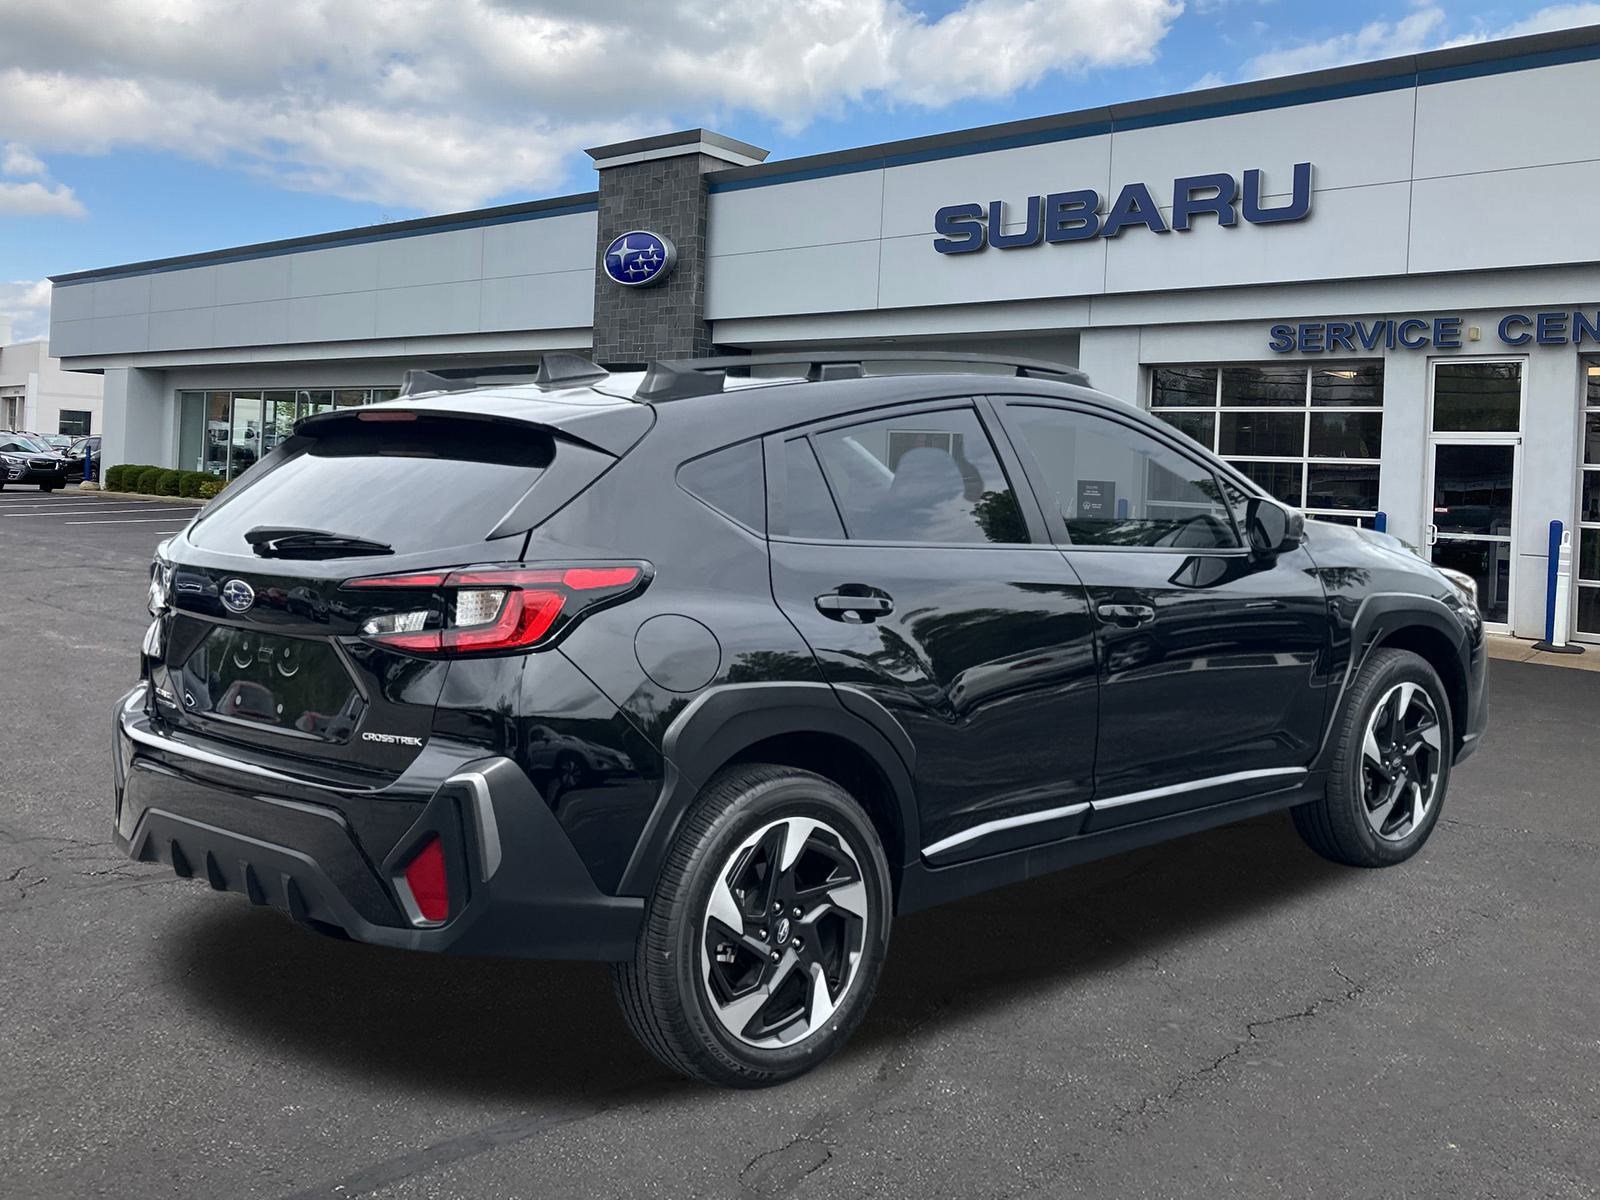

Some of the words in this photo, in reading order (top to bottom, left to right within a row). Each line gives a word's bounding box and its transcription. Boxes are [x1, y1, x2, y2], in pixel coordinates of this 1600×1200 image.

[934, 162, 1313, 254] SUBARU
[1268, 317, 1463, 352] SERVICE
[1497, 311, 1600, 346] CEN
[361, 731, 423, 747] CROSSTREK
